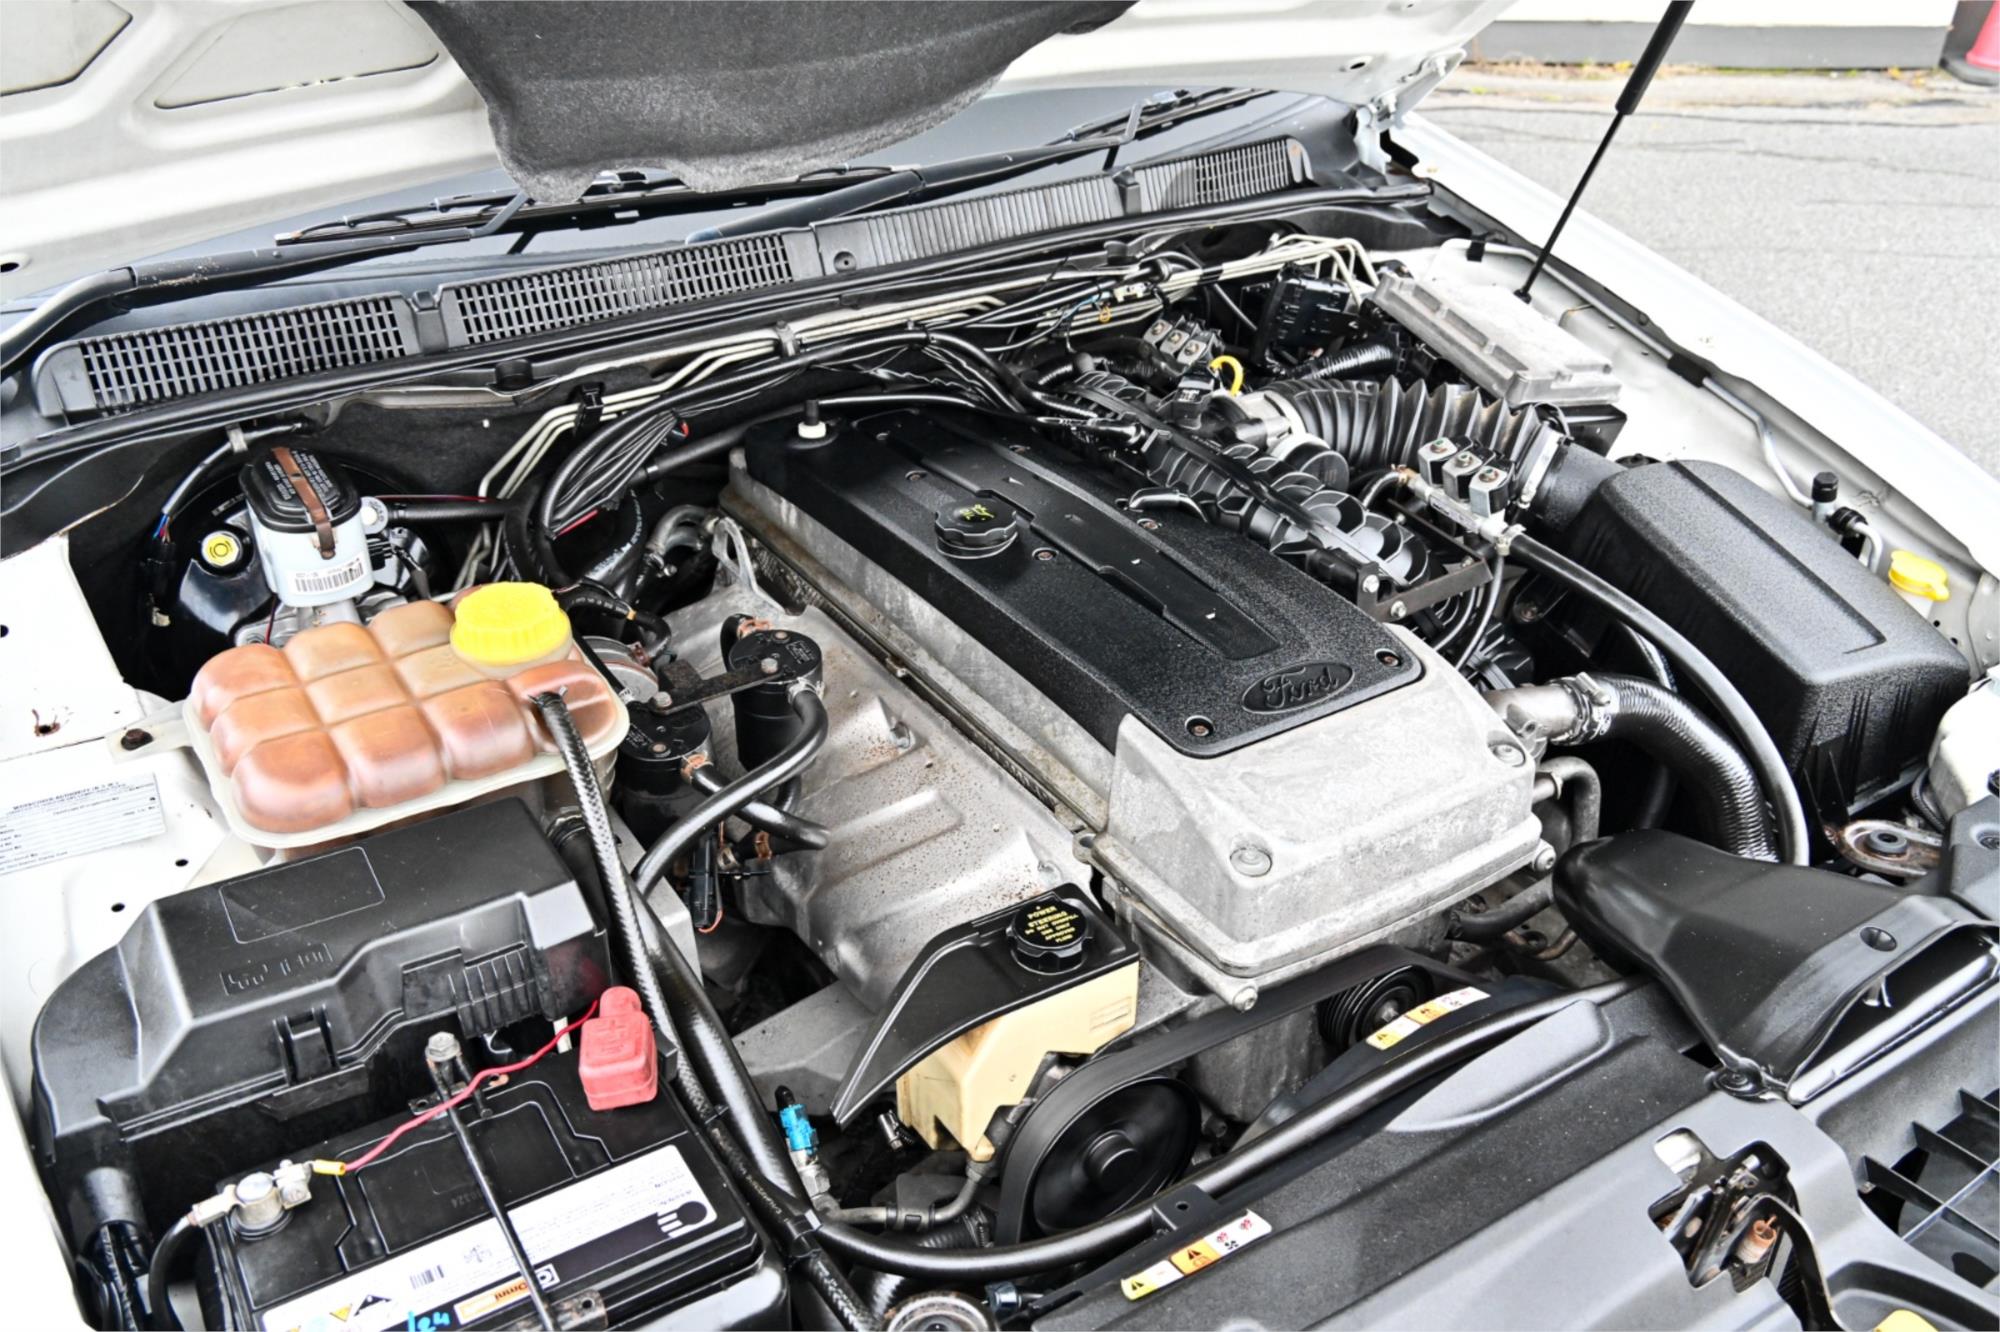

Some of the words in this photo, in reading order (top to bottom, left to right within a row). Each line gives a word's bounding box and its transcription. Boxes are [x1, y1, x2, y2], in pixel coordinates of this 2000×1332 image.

[1263, 666, 1339, 709] Ford
[1027, 906, 1057, 919] POWER
[1028, 911, 1067, 927] STEERING
